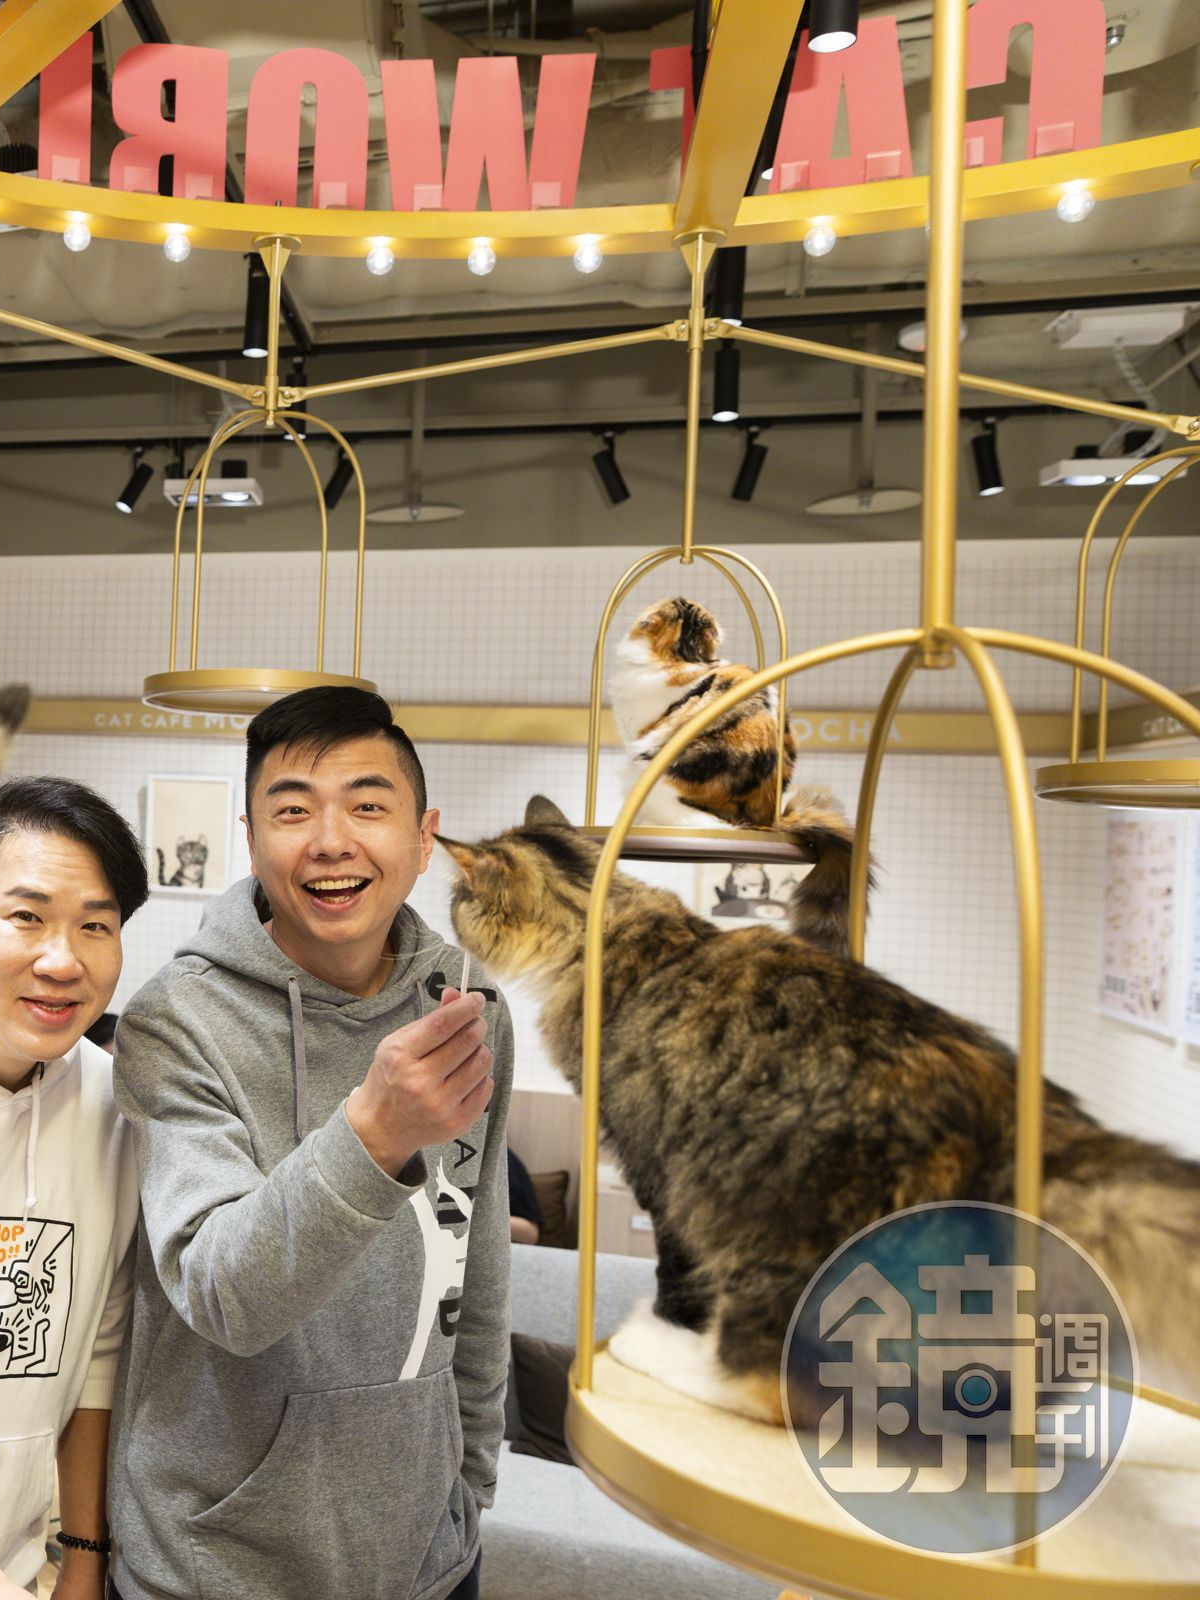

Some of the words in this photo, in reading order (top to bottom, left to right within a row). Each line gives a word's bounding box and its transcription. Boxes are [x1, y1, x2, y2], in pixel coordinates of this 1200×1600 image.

[94, 713, 133, 728] CAT
[140, 713, 193, 729] CAFE
[790, 718, 902, 743] OCH
